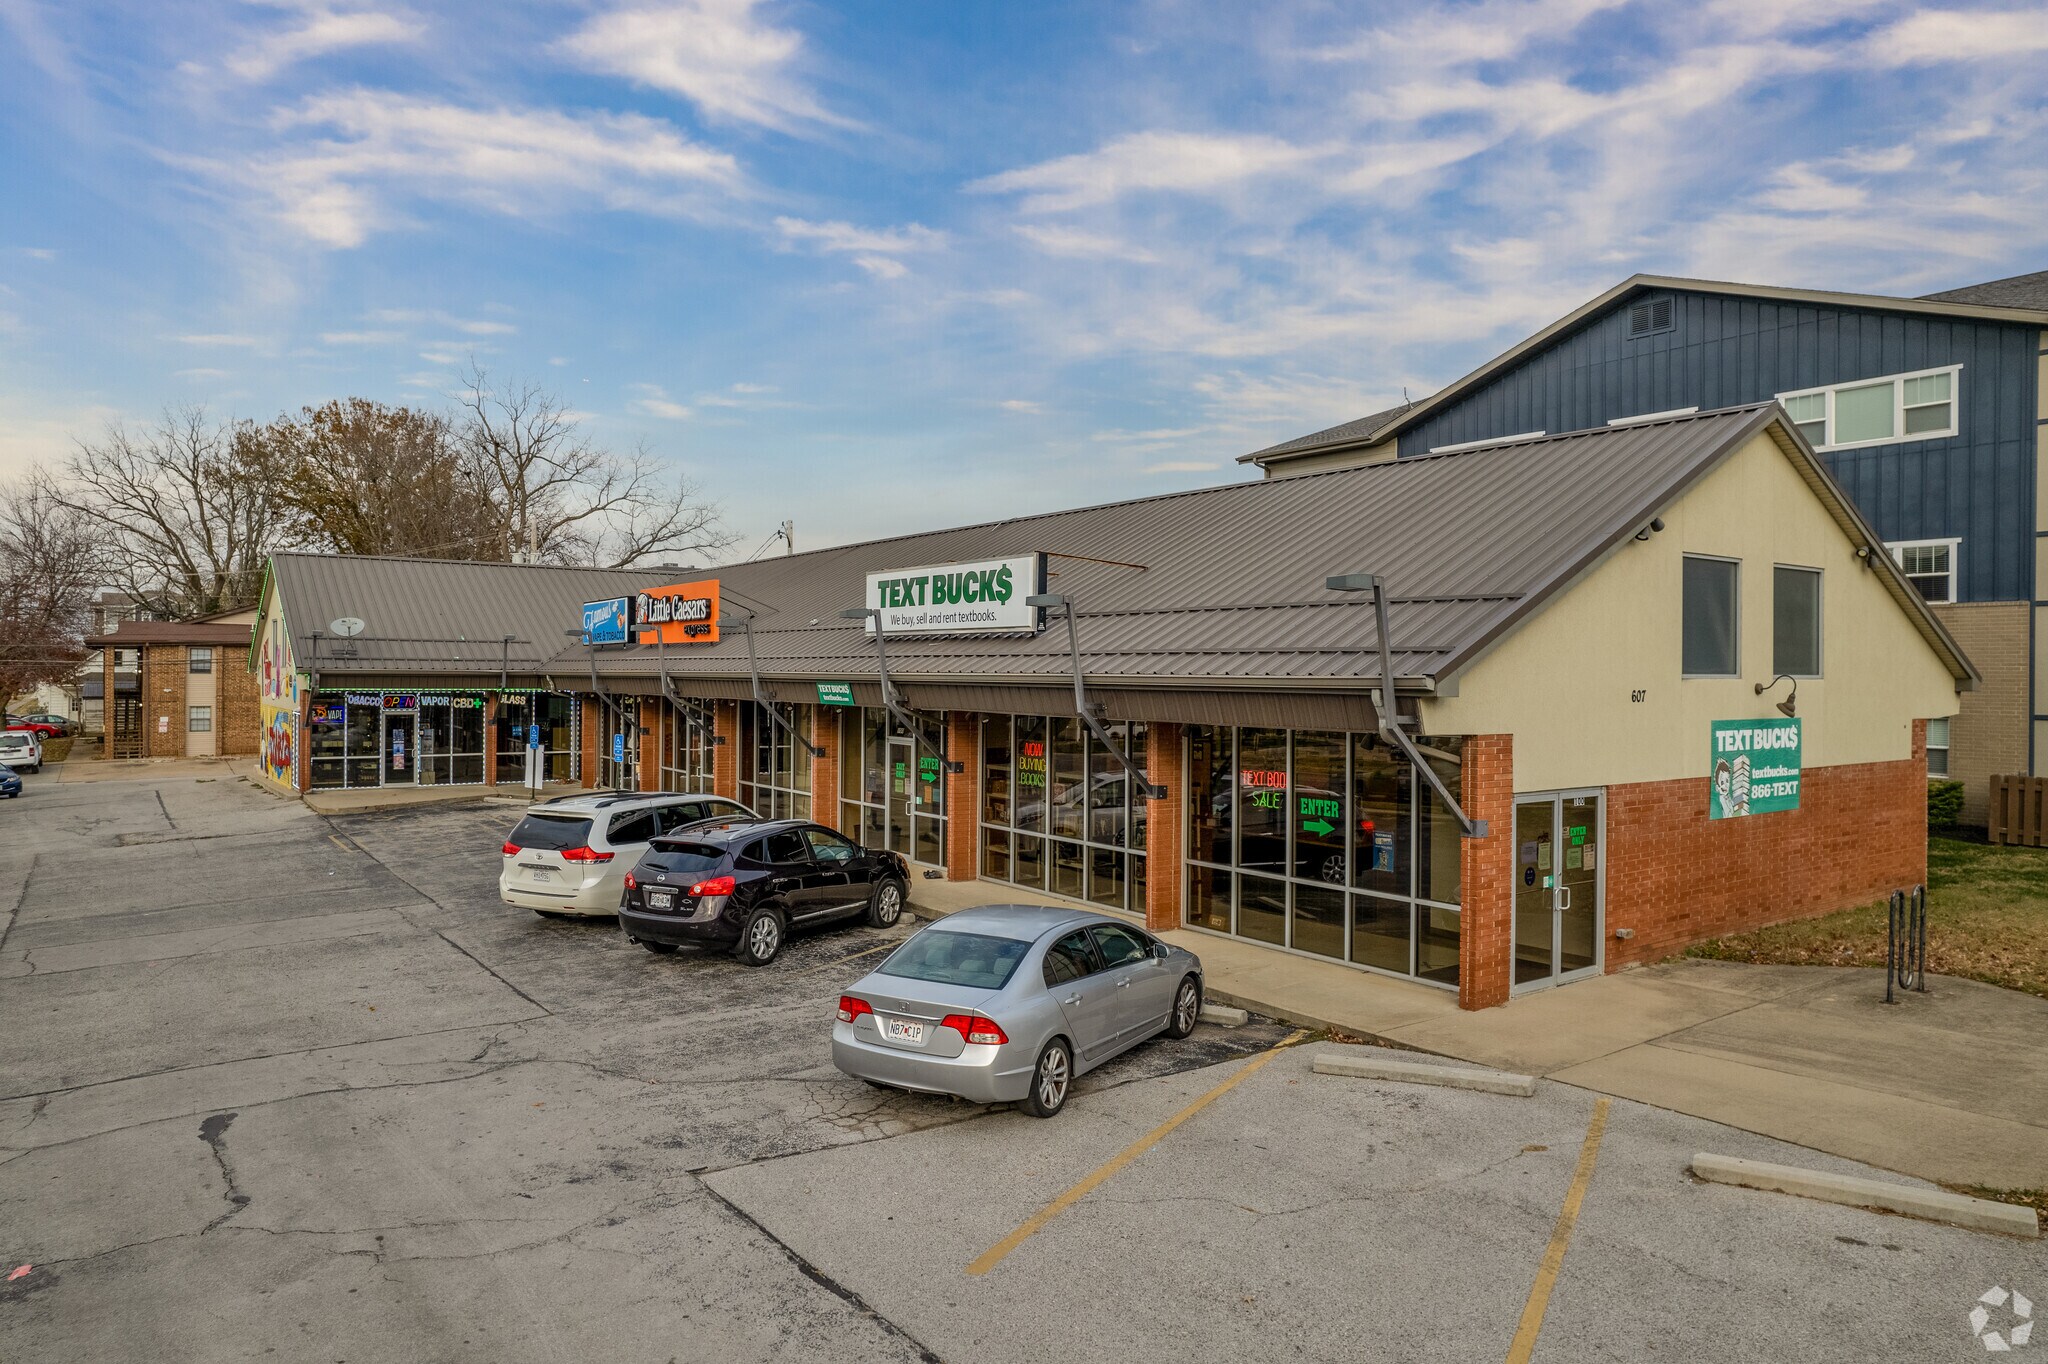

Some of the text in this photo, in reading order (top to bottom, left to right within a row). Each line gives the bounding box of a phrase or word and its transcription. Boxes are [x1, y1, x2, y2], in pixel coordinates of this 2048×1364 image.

[878, 564, 1013, 608] TEXT BUCK$
[648, 595, 709, 622] Little Caesars
[891, 609, 997, 627] We buy, sell and rent textbooks.
[684, 624, 711, 637] express
[346, 694, 381, 706] OBACCO
[384, 696, 415, 708] OPEN
[420, 695, 450, 706] VAPOR
[1631, 689, 1647, 702] 607
[327, 709, 343, 720] VAPE
[1715, 725, 1798, 752] TEXT BUCK$
[1024, 742, 1044, 757] NOW
[920, 757, 939, 770] ENTER
[1019, 757, 1047, 771] BUYING
[1020, 772, 1045, 787] BOOKS
[1242, 770, 1287, 788] TEXT BOO
[1752, 765, 1799, 779] textbucks.com
[1751, 781, 1798, 799] 866-TEXT
[1252, 791, 1280, 809] SALE
[1300, 797, 1339, 818] ENTER
